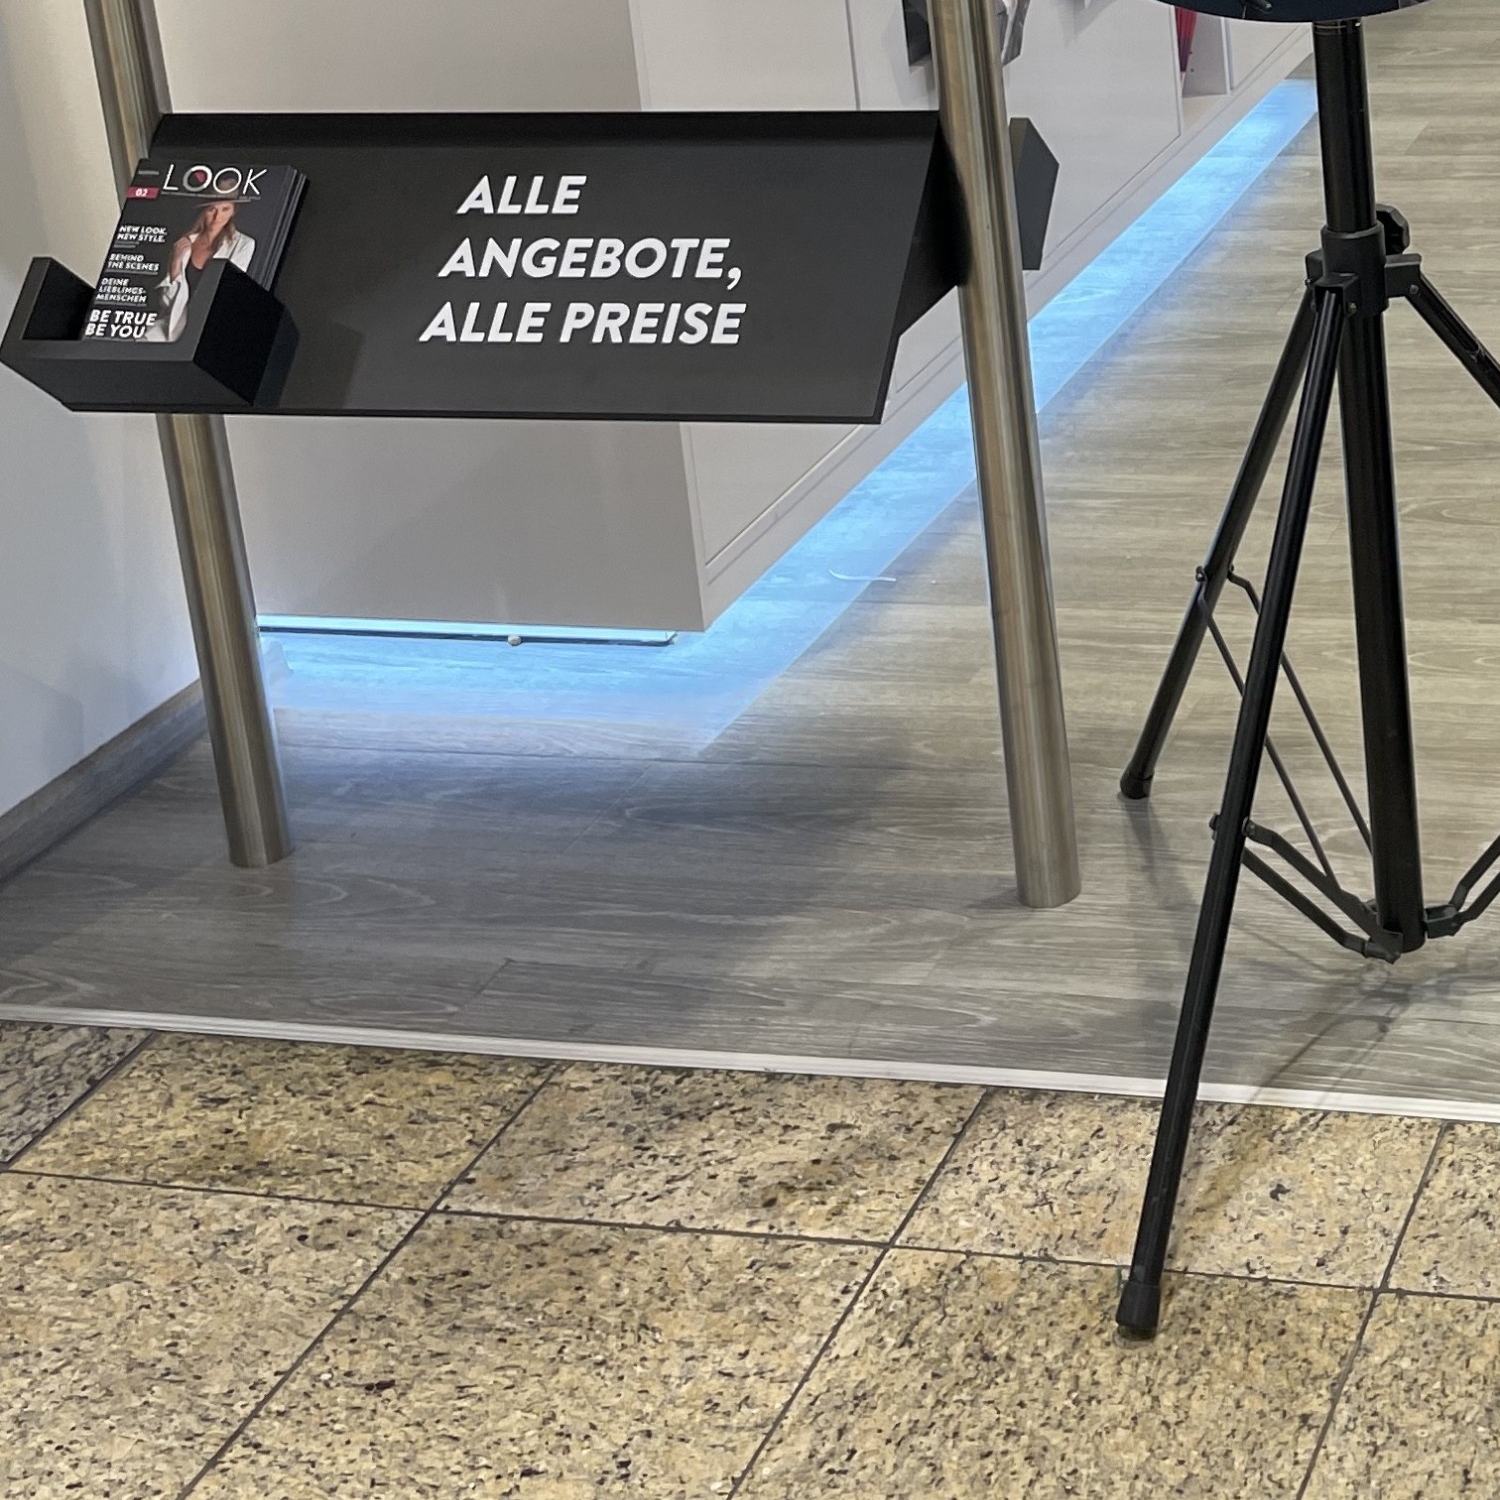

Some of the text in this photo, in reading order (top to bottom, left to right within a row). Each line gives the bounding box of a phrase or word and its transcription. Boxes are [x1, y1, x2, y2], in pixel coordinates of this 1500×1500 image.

[162, 164, 268, 195] LOOK
[456, 175, 589, 215] ALLE
[437, 237, 744, 289] ANGEBOTE,
[85, 324, 146, 338] BE YOU
[89, 310, 158, 326] BE TRUE
[418, 302, 748, 345] ALLE PREISE
